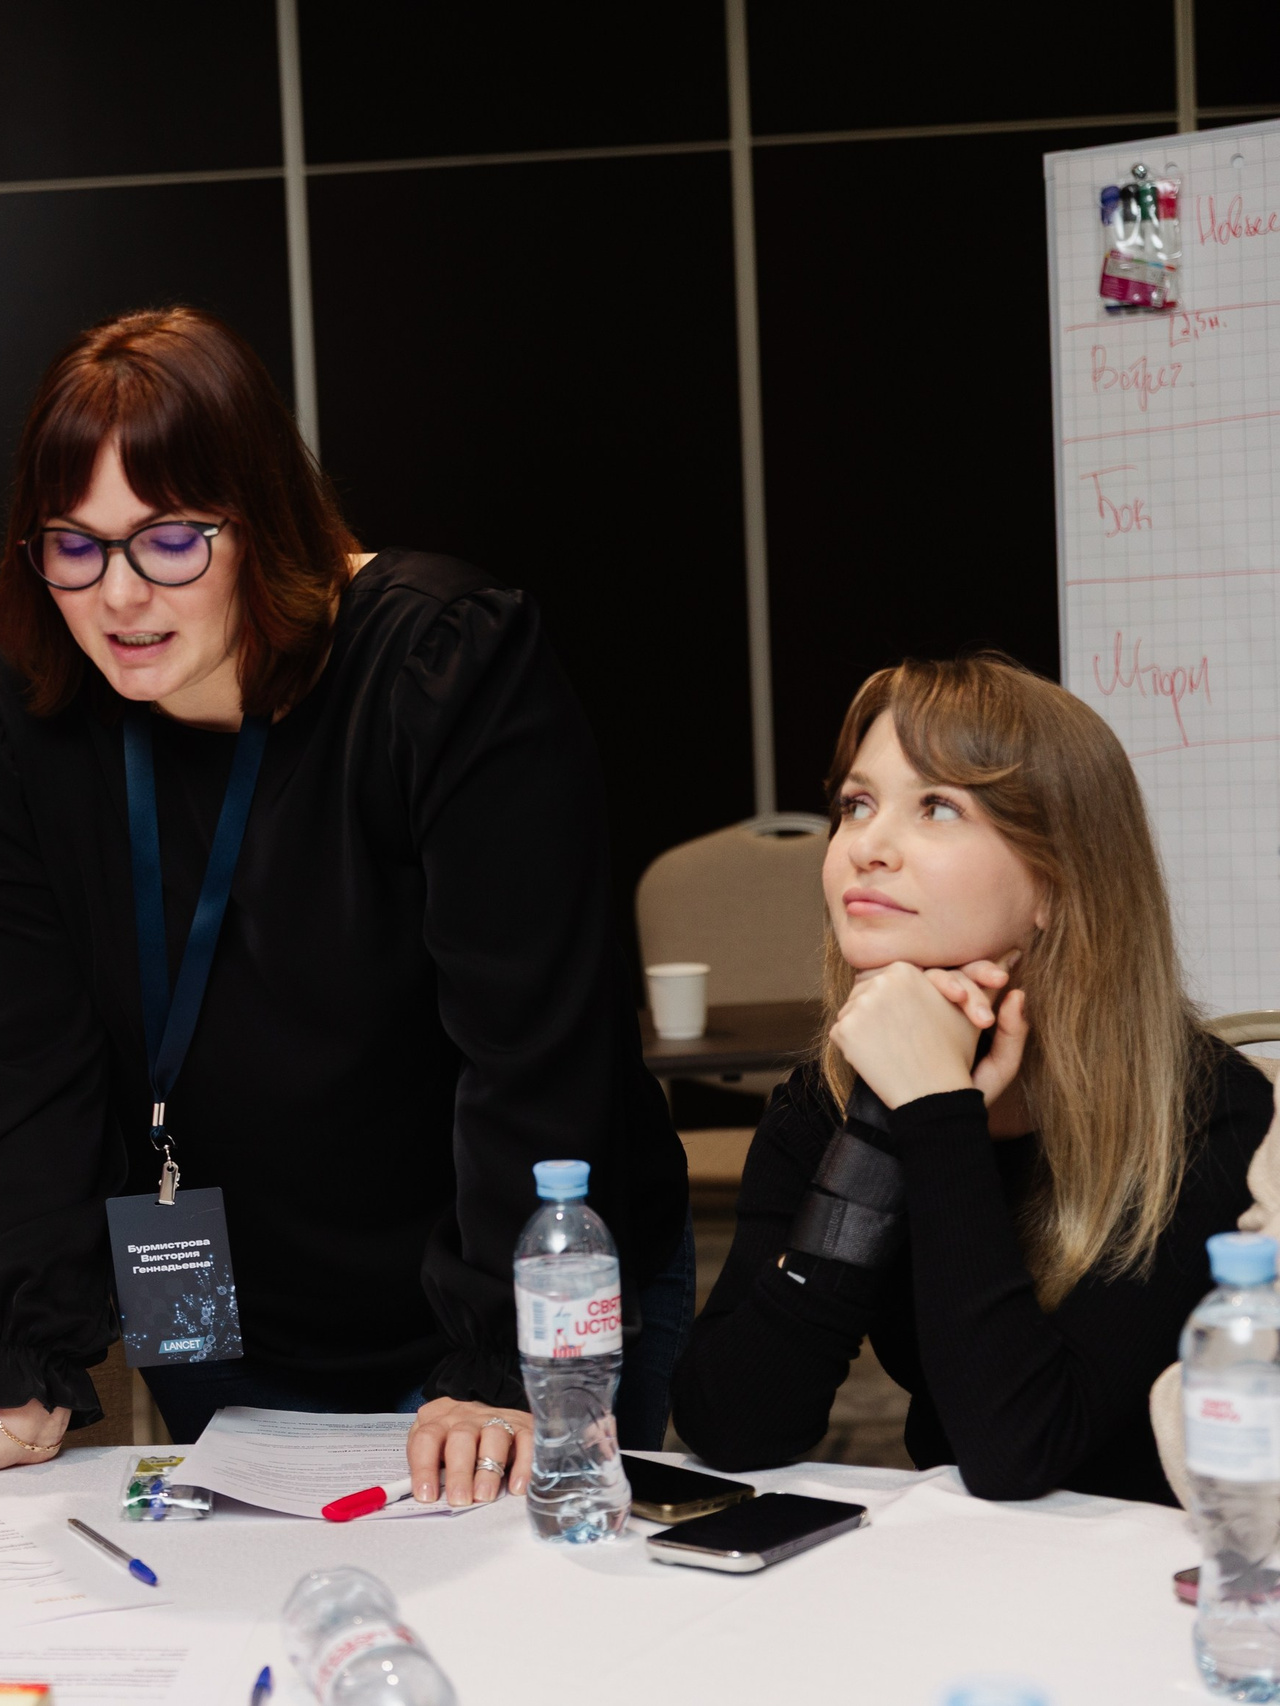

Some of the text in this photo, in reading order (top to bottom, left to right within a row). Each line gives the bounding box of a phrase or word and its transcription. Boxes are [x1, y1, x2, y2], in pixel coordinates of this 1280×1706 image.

[127, 1238, 211, 1254] Бурмистрова
[140, 1250, 200, 1263] Виктория
[132, 1260, 211, 1275] Геннадьевна
[163, 1339, 201, 1351] LANCET
